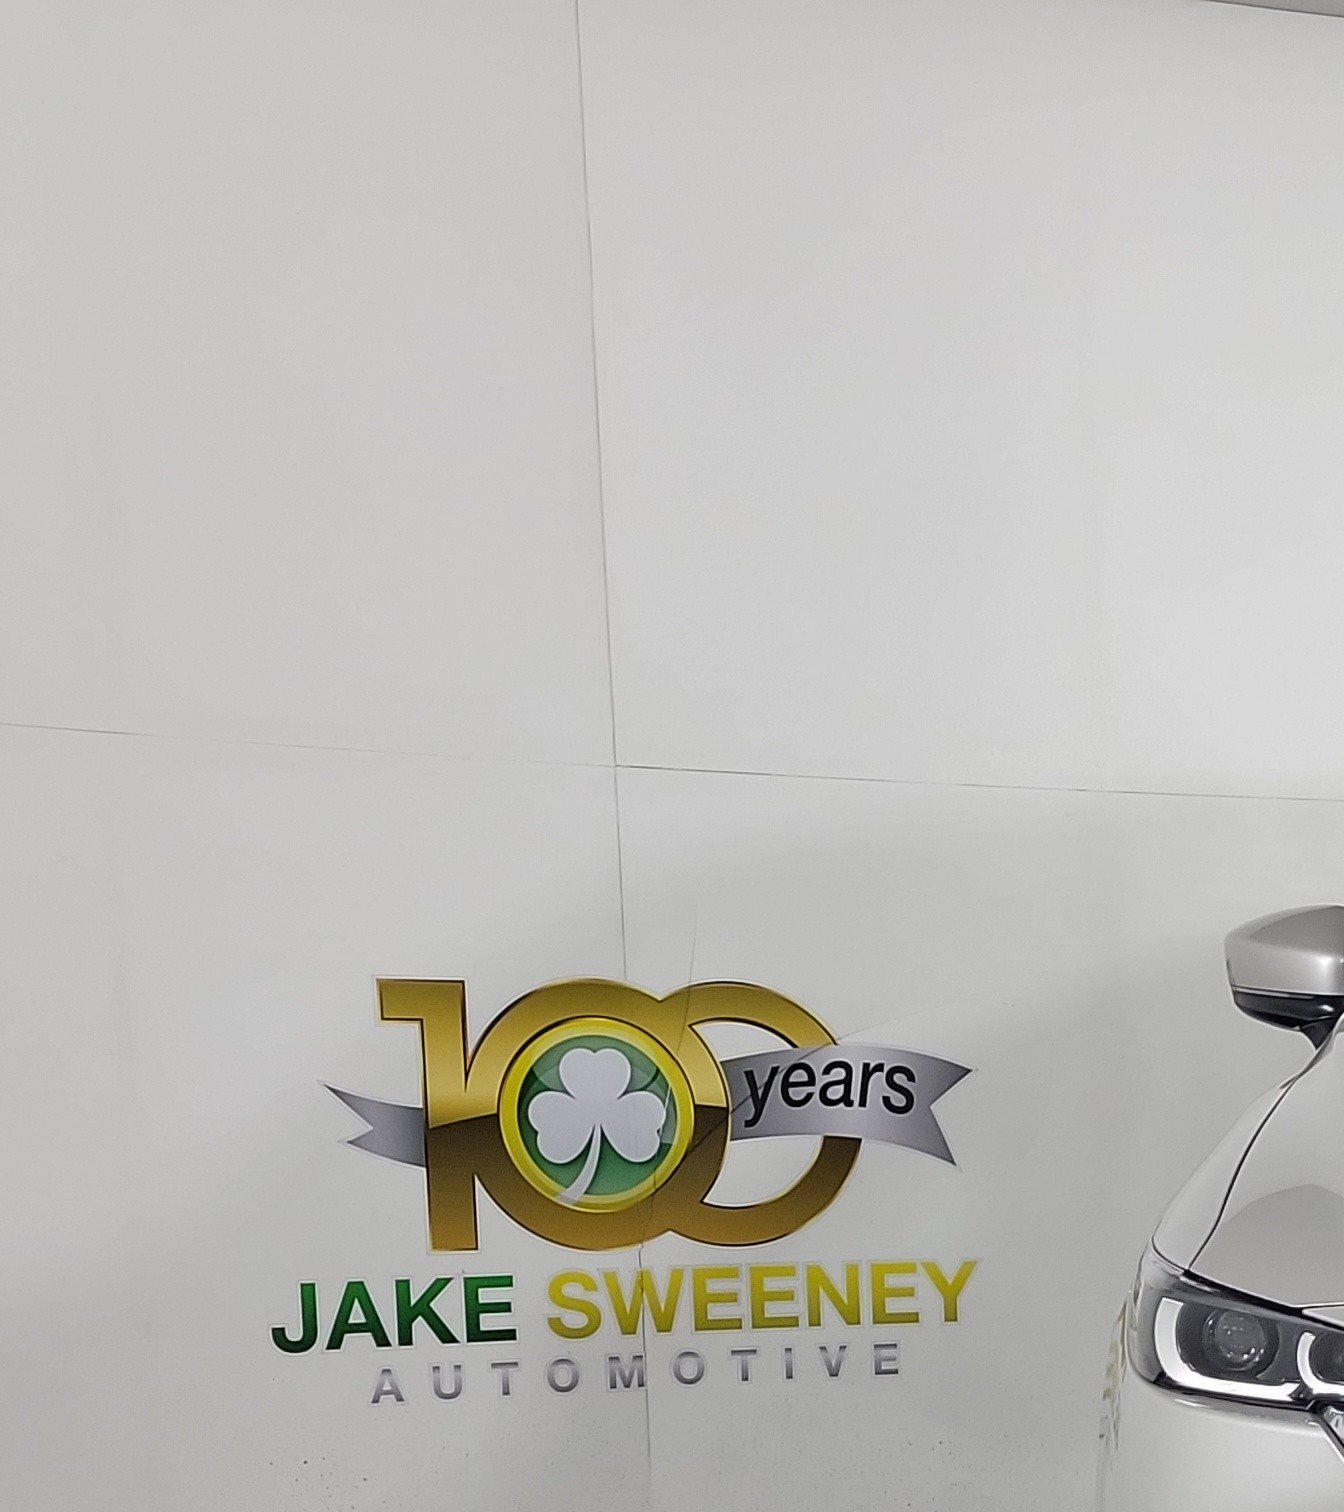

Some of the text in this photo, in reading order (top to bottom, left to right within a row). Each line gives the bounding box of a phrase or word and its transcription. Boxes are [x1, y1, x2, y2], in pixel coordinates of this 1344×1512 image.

[376, 977, 916, 1251] 100 years
[270, 1260, 977, 1354] JAKE SWEENEY
[370, 1343, 900, 1404] AUTOMOTIVE
